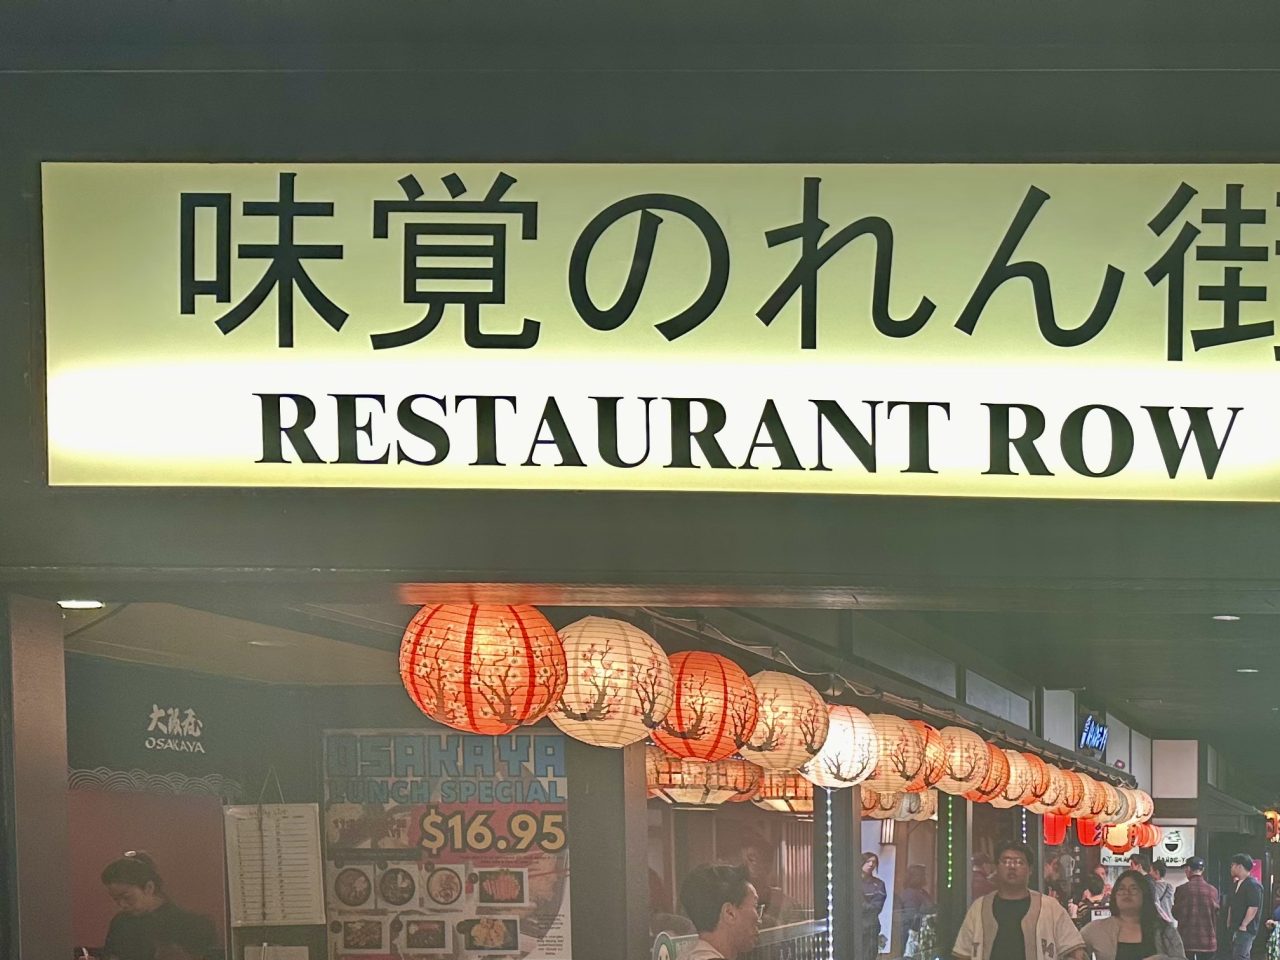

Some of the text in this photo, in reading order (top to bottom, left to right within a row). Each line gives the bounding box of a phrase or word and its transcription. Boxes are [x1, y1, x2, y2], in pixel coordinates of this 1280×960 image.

[252, 391, 1244, 480] RESTAURANT ROW
[145, 737, 206, 754] OSAKAYA
[326, 735, 567, 777] OSAKAYA
[330, 780, 567, 804] LUNCH SPECIAL
[421, 806, 567, 857] $16.95
